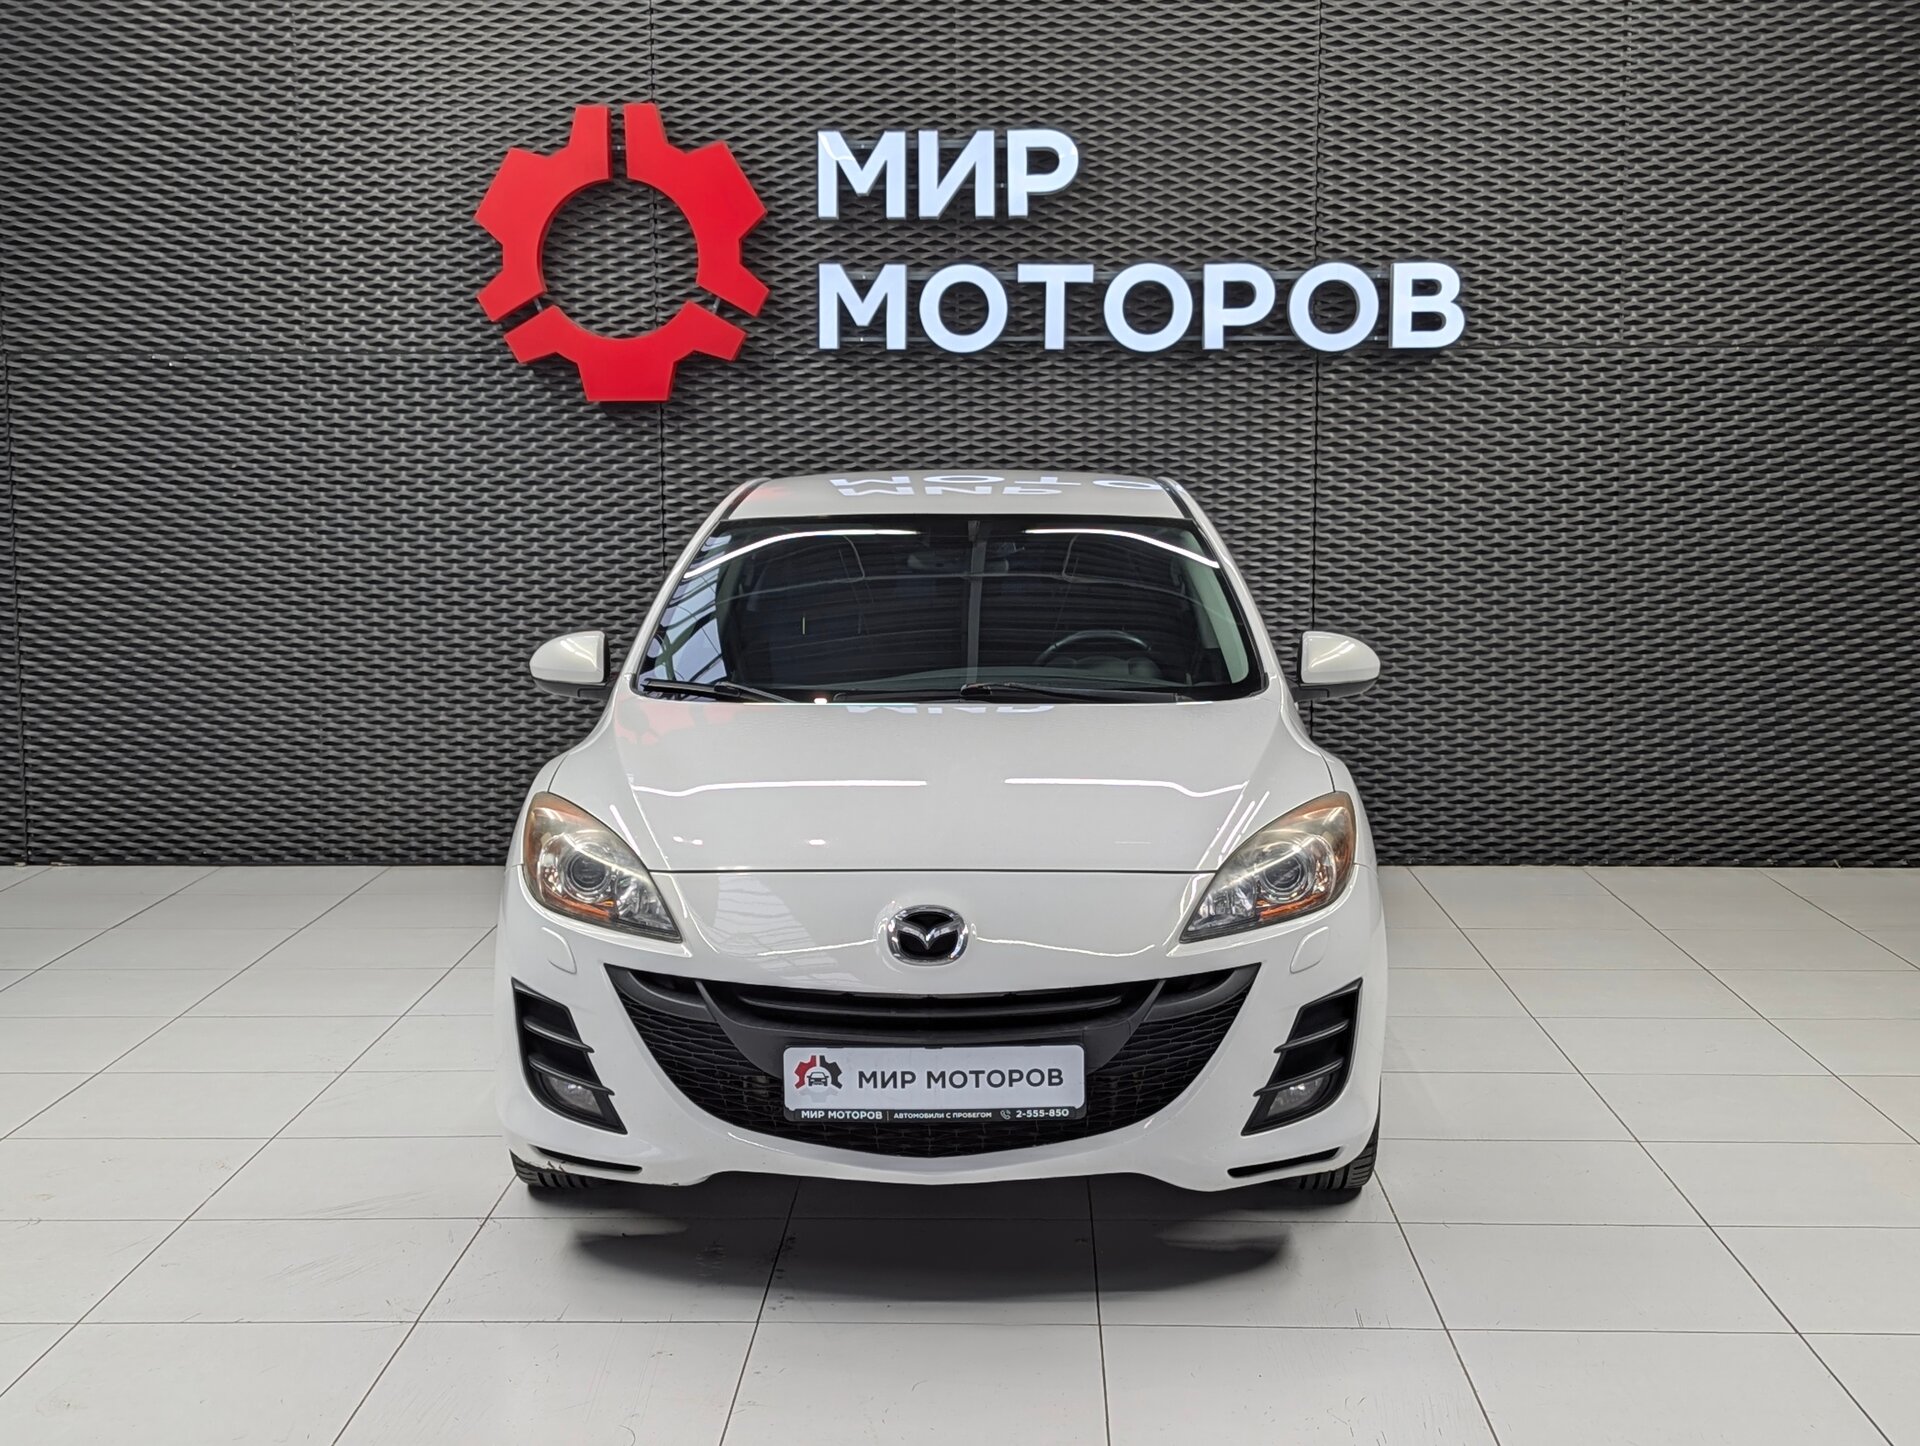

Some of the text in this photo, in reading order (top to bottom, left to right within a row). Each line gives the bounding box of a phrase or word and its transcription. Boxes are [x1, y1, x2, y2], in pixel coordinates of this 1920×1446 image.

[817, 129, 1080, 219] МИР
[817, 261, 1466, 353] МОТОРОВ
[858, 1068, 1064, 1089] МИР МОТОРОВ
[801, 1110, 825, 1119] МИР
[828, 1110, 883, 1120] МОТОРОВ
[1015, 1108, 1069, 1118] 2-555-850
